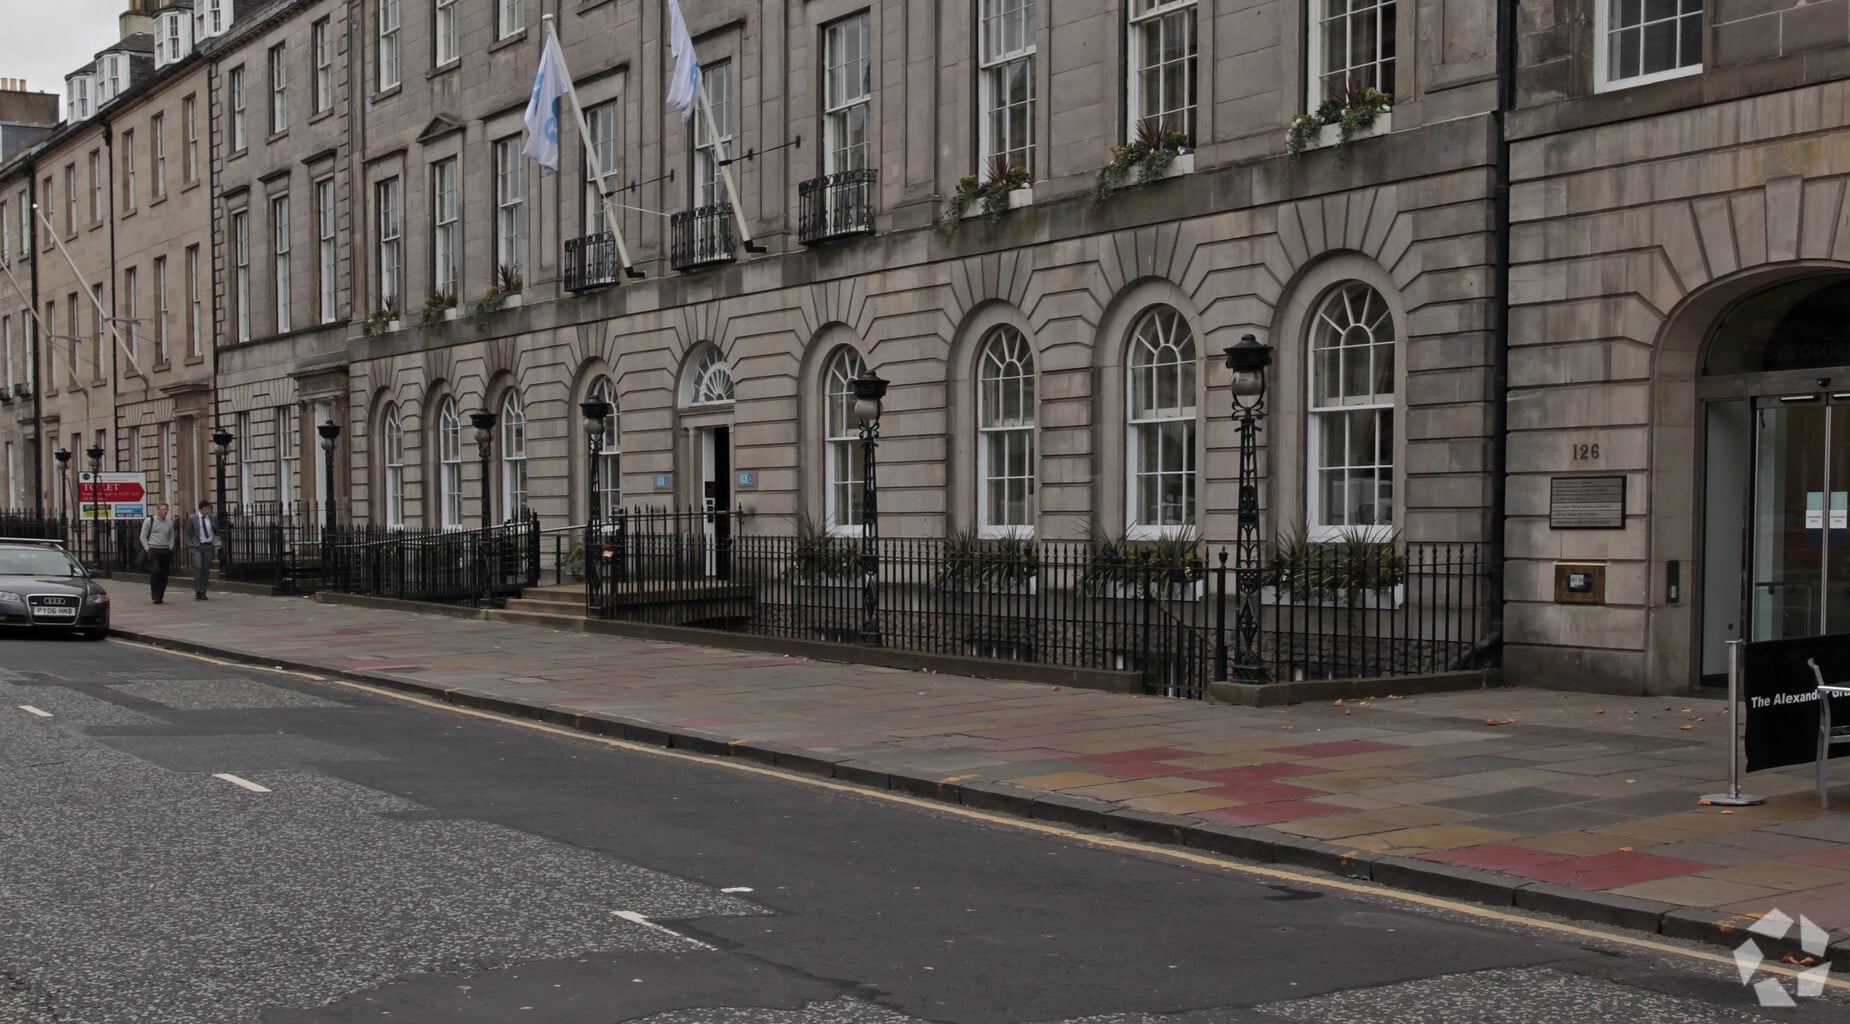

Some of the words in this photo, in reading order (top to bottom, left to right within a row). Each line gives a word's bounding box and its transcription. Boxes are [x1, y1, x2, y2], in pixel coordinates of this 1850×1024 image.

[1572, 443, 1600, 461] 126
[1751, 696, 1771, 709] The
[1773, 689, 1830, 706] Alexand
